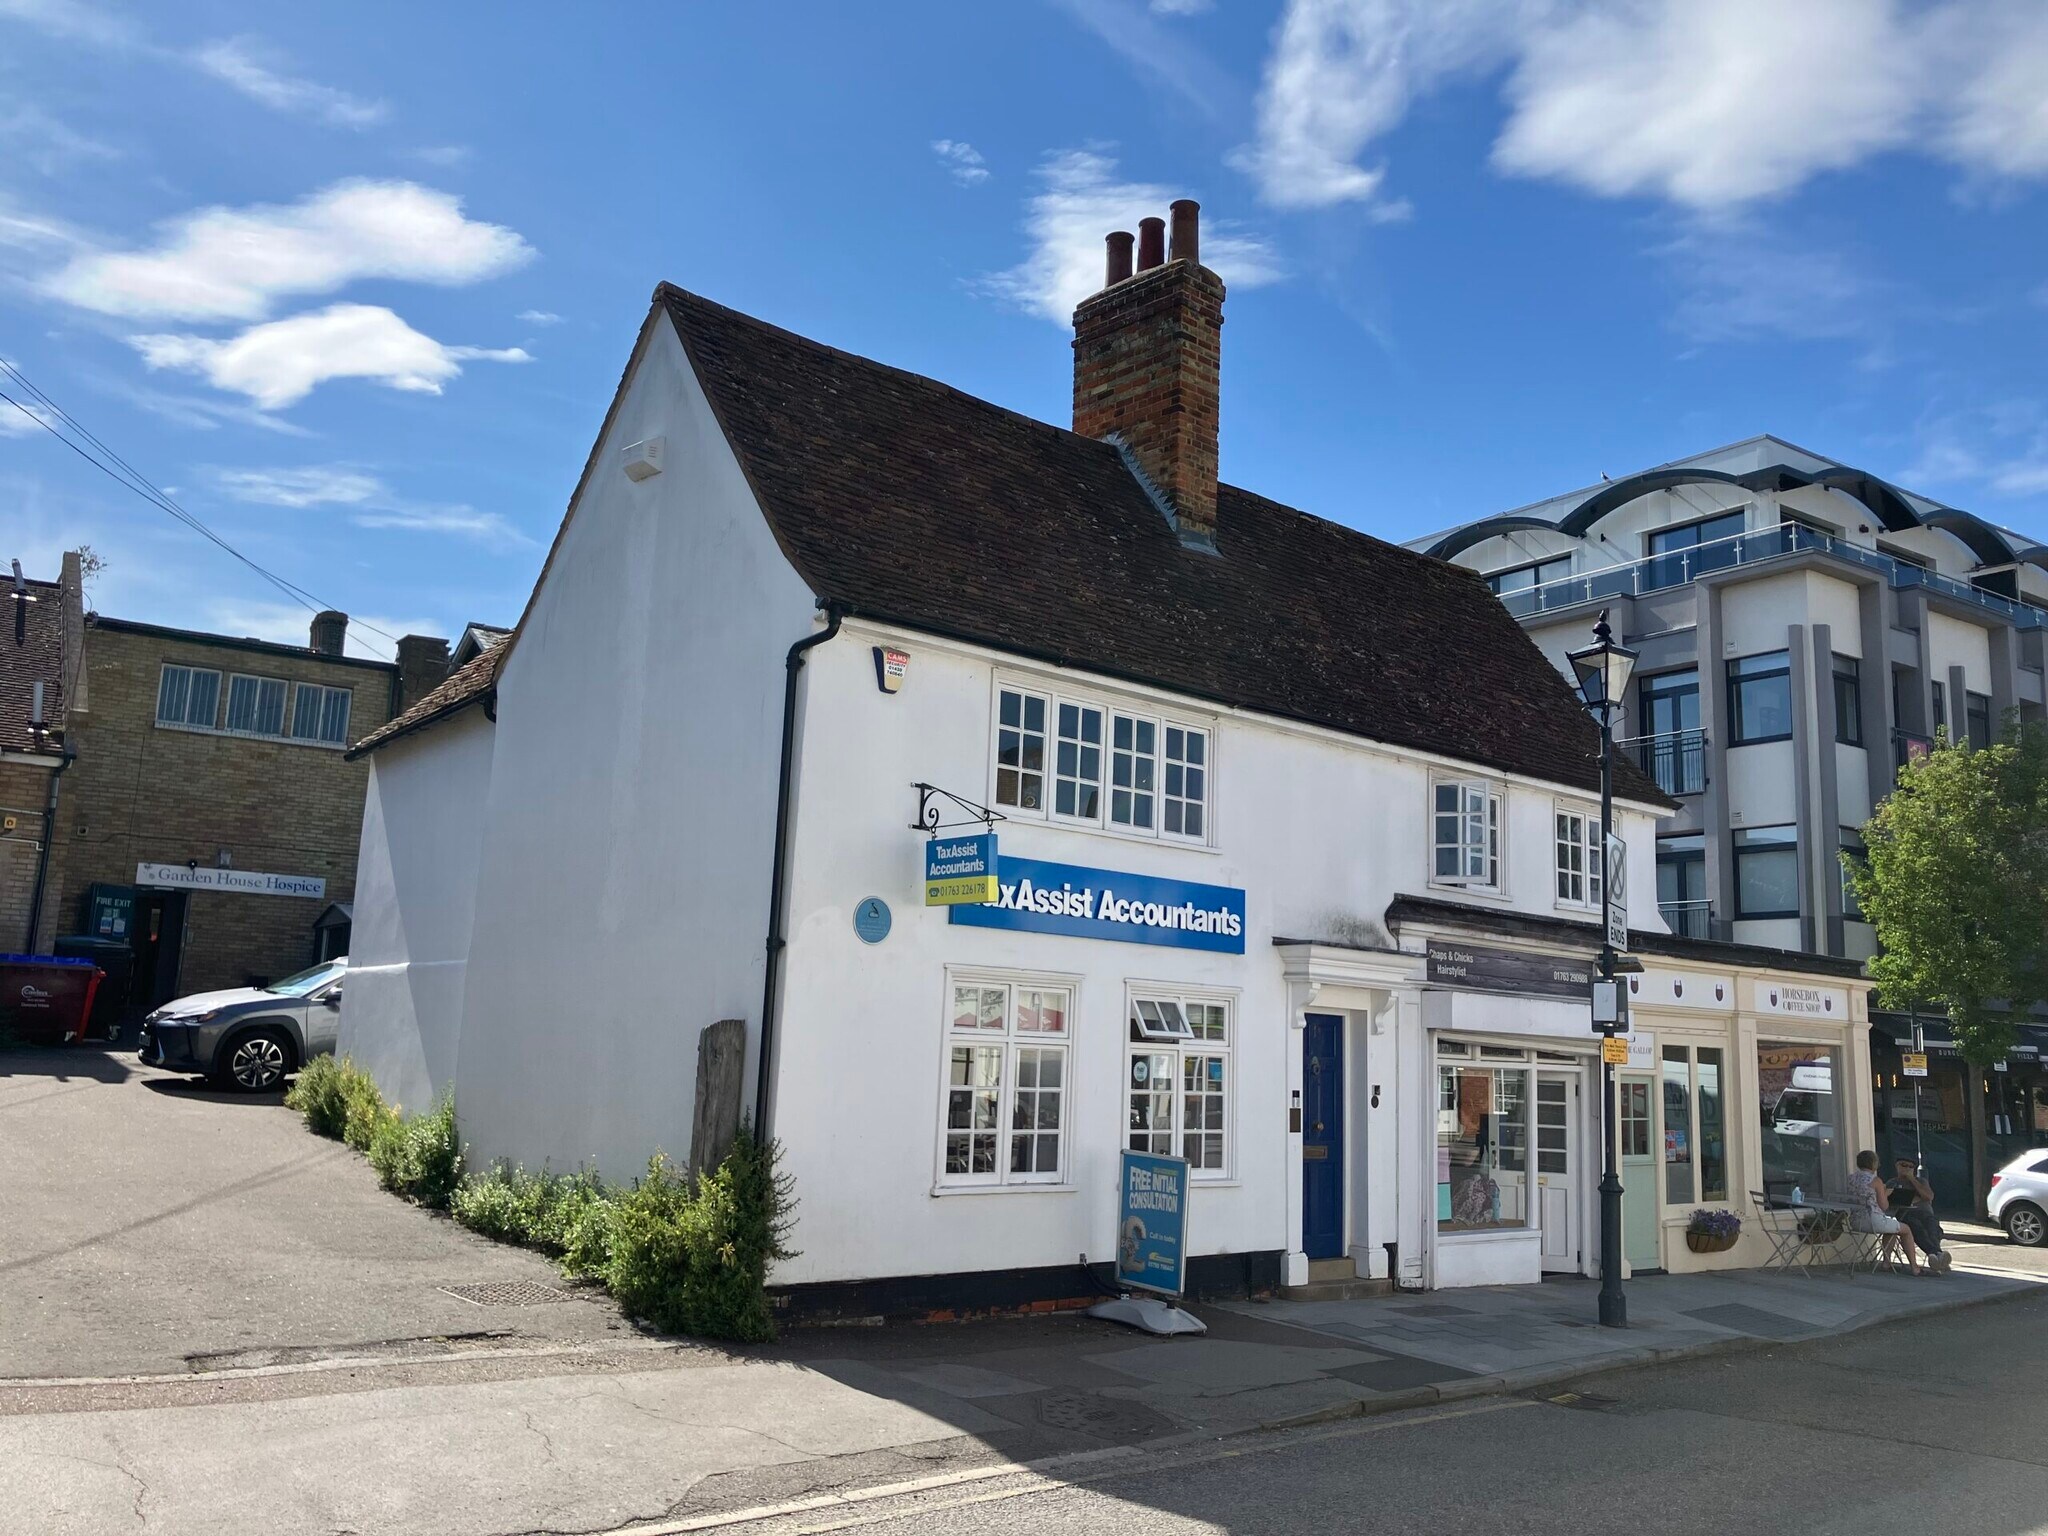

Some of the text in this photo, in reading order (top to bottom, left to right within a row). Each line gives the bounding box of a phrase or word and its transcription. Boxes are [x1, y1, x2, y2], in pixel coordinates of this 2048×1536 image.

[888, 652, 907, 662] CAMS
[936, 842, 978, 860] TaxAssist
[930, 859, 985, 876] Accountants
[158, 867, 321, 893] Garden House Hospice
[940, 883, 986, 896] 01763 226178
[96, 896, 131, 908] FIRE EXIT
[973, 879, 1241, 936] xAssist Accountants
[1612, 911, 1623, 926] Zone
[1611, 926, 1625, 945] ENDS
[1448, 951, 1454, 961] &
[1454, 952, 1474, 964] Chicks
[1437, 964, 1467, 977] Hairstylist
[1553, 970, 1569, 982] 01763
[1782, 987, 1820, 1002] HORSEBOX
[1782, 1001, 1821, 1013] COFFEE SHOP
[1633, 1045, 1652, 1055] GALLOP
[1130, 1166, 1178, 1195] FREE INITIAL
[1129, 1191, 1178, 1213] CONSULTATION
